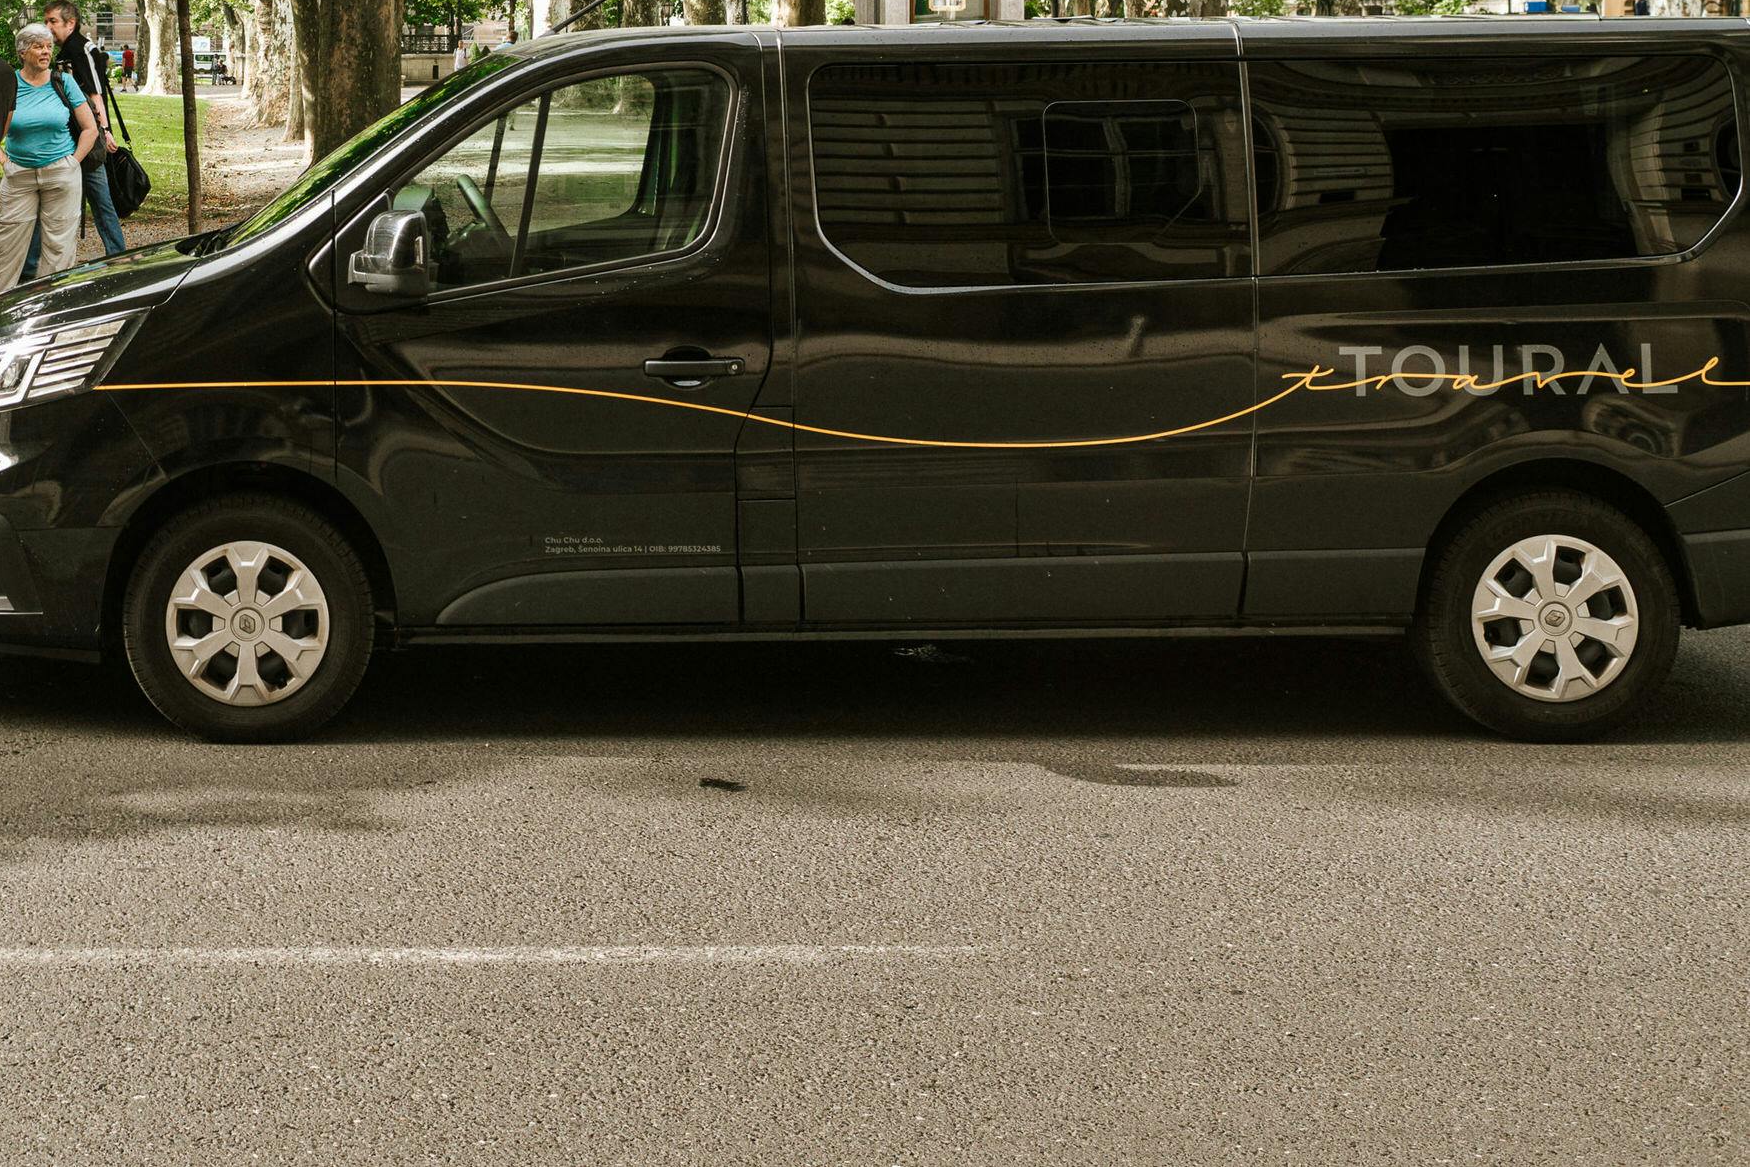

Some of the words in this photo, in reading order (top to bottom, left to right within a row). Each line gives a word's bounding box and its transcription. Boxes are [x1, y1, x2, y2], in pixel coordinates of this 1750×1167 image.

[1280, 356, 1722, 390] travel
[1338, 342, 1679, 397] TOURAL
[544, 545, 577, 553] Zagreb,
[612, 545, 632, 553] ulica
[668, 545, 721, 553] 99785324385
[563, 536, 580, 544] Chu
